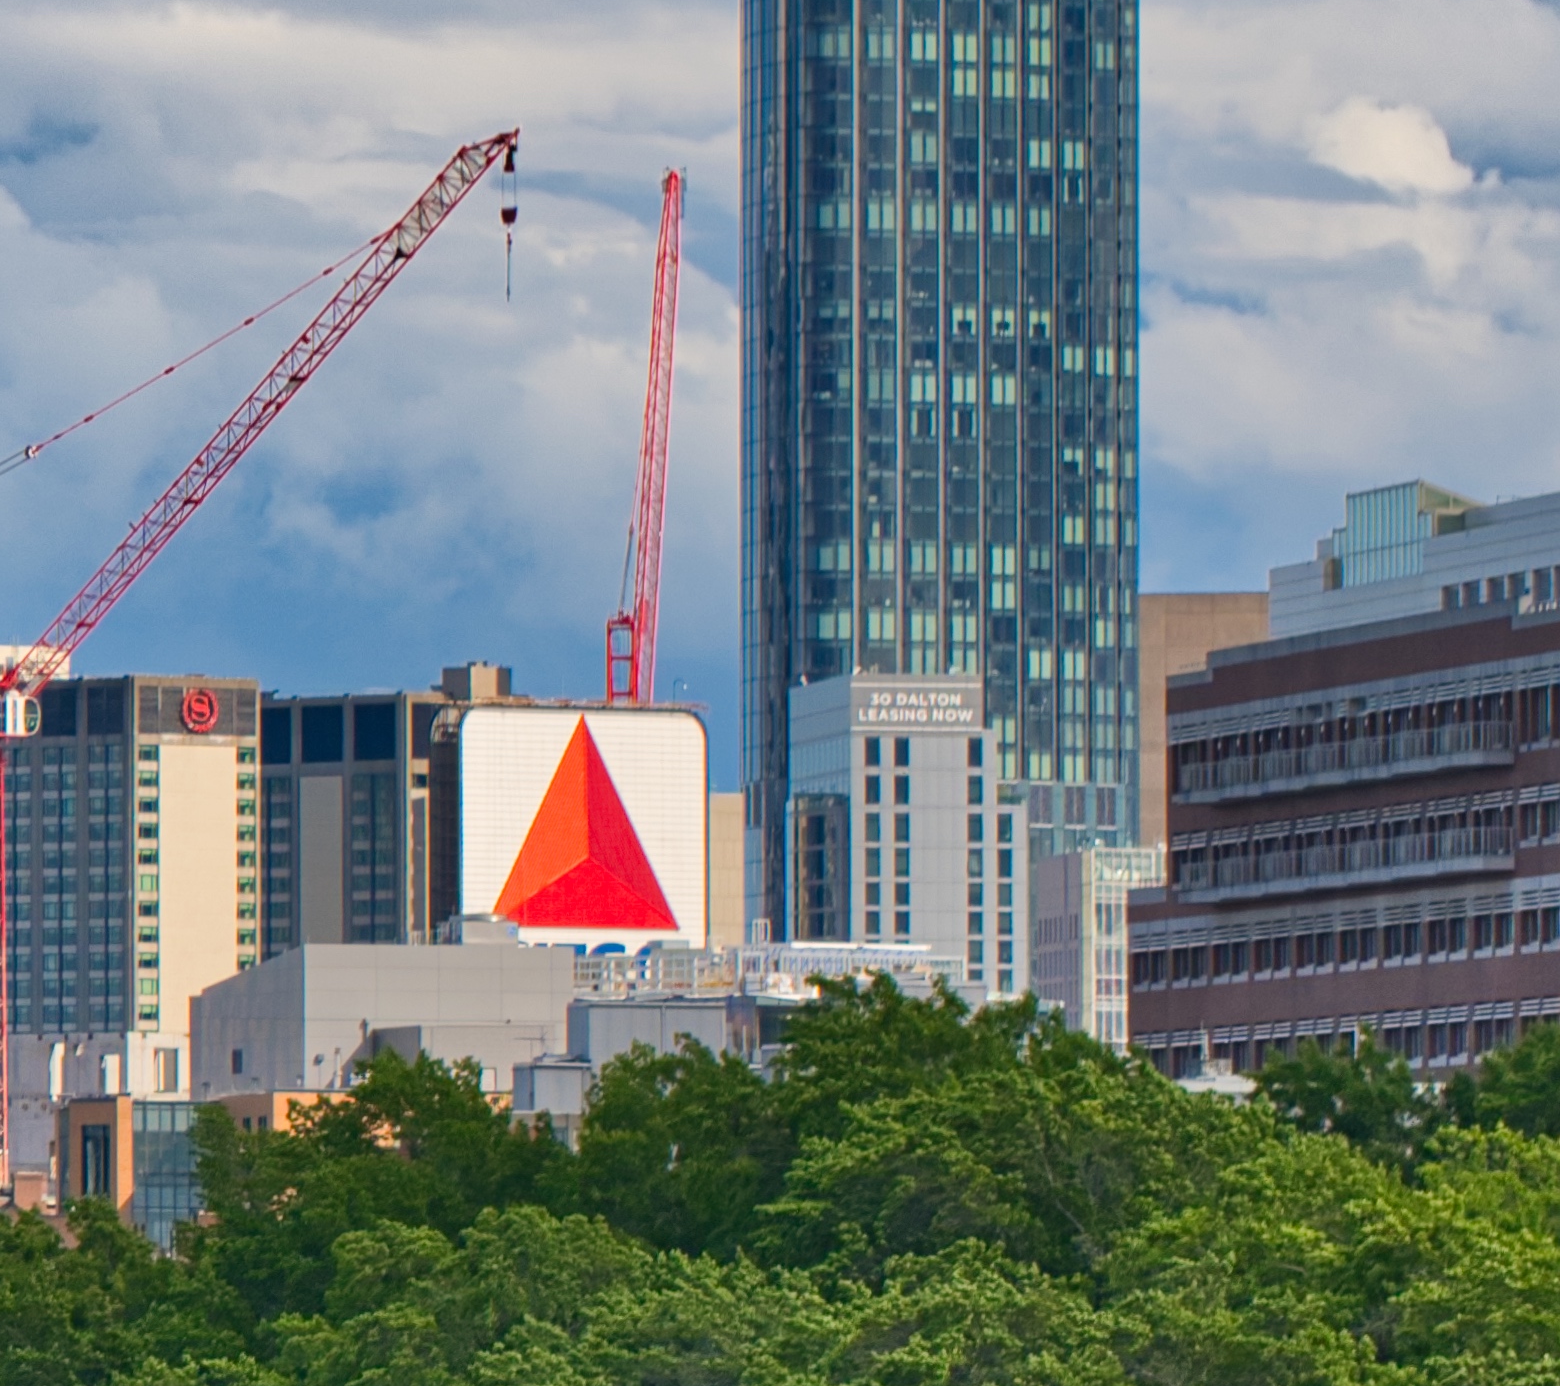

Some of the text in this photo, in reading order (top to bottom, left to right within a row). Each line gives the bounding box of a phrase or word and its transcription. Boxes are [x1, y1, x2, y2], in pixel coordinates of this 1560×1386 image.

[870, 692, 962, 707] 30 DALTON
[858, 708, 974, 722] LEASING NOW
